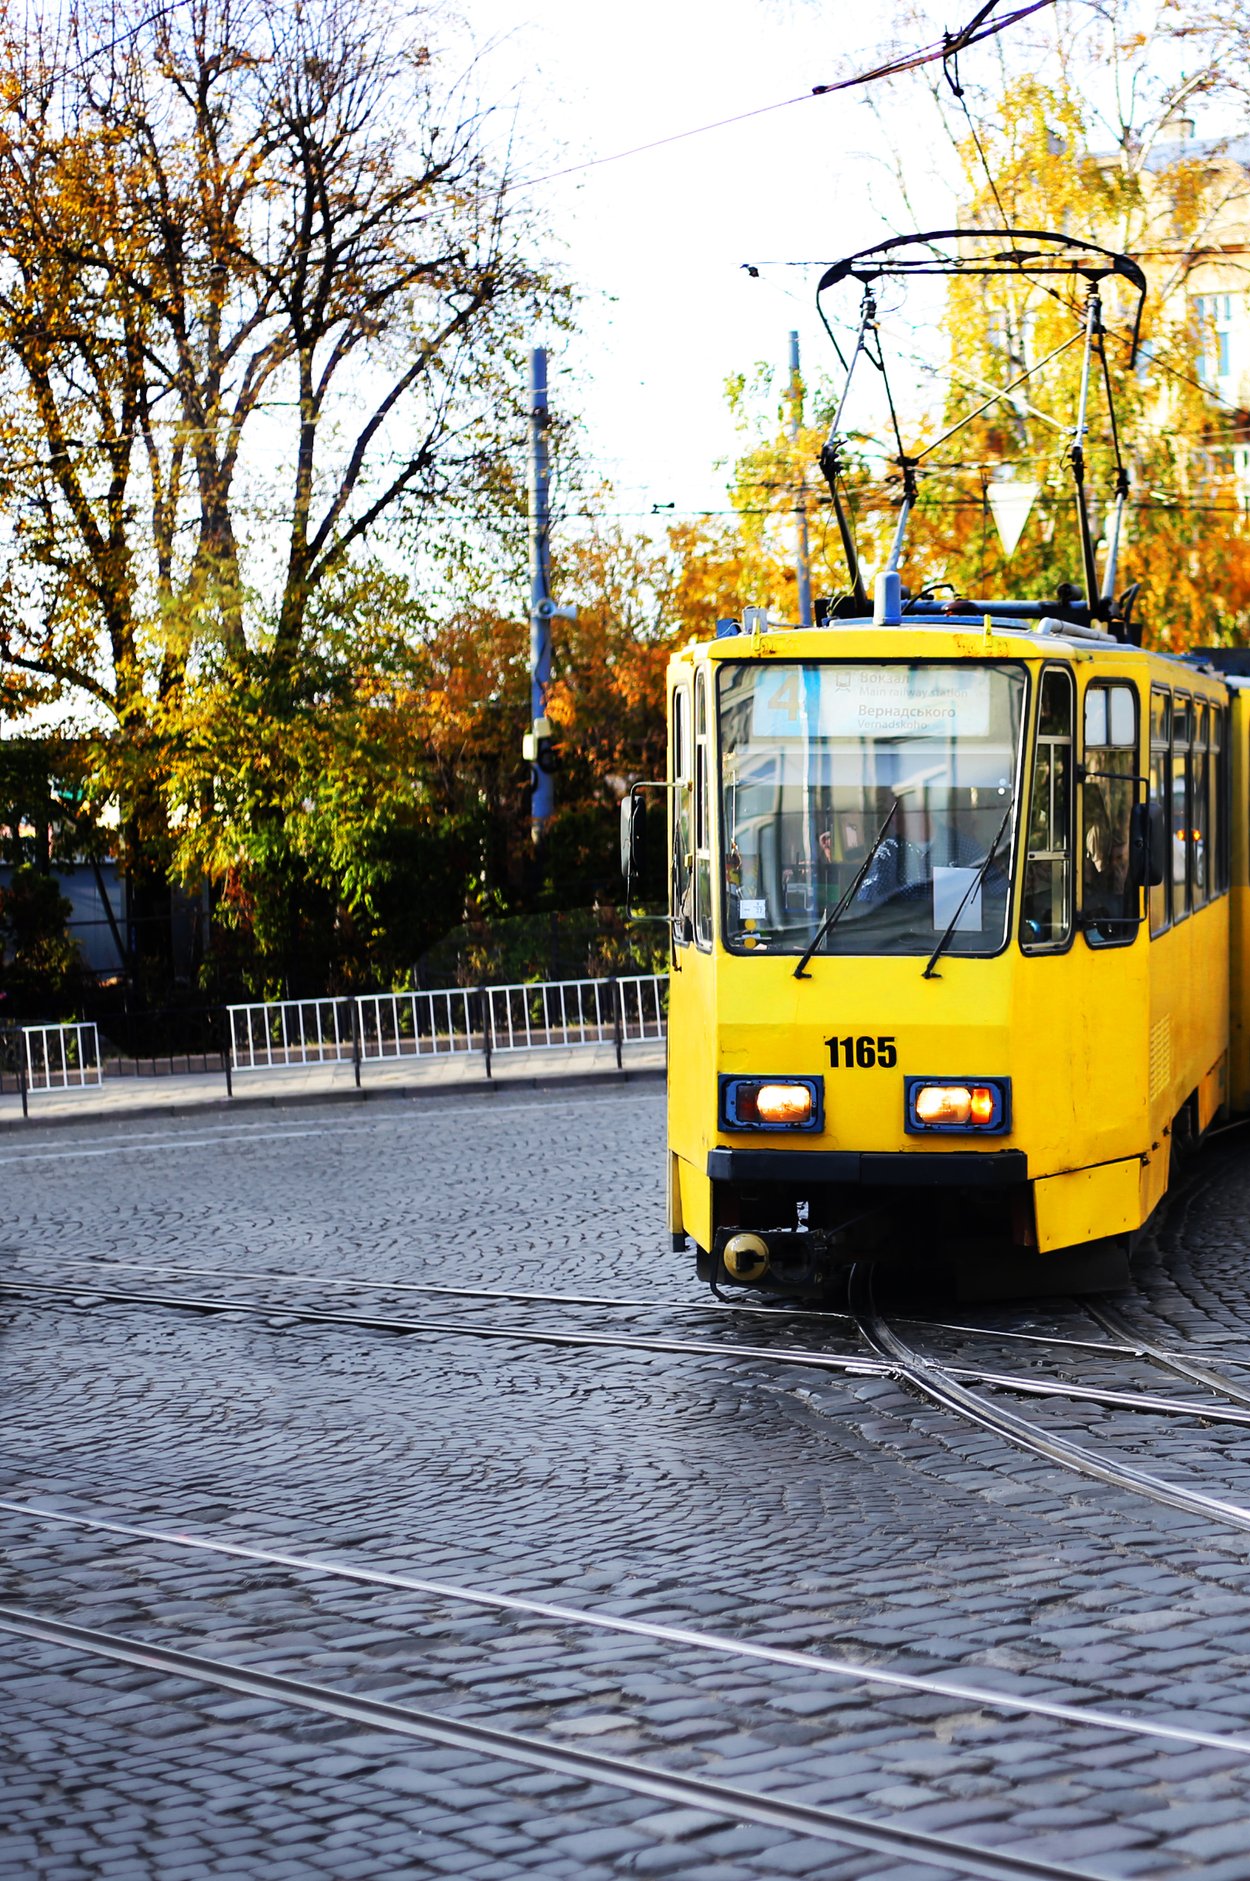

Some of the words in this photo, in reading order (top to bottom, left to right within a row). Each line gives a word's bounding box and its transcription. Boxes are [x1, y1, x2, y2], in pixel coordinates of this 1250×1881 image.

[860, 671, 909, 684] Вокзал
[768, 673, 797, 721] 4
[859, 687, 887, 697] Main
[858, 704, 956, 718] Вернадського
[857, 719, 928, 730] Vernadskoho
[824, 1036, 897, 1068] 1165
